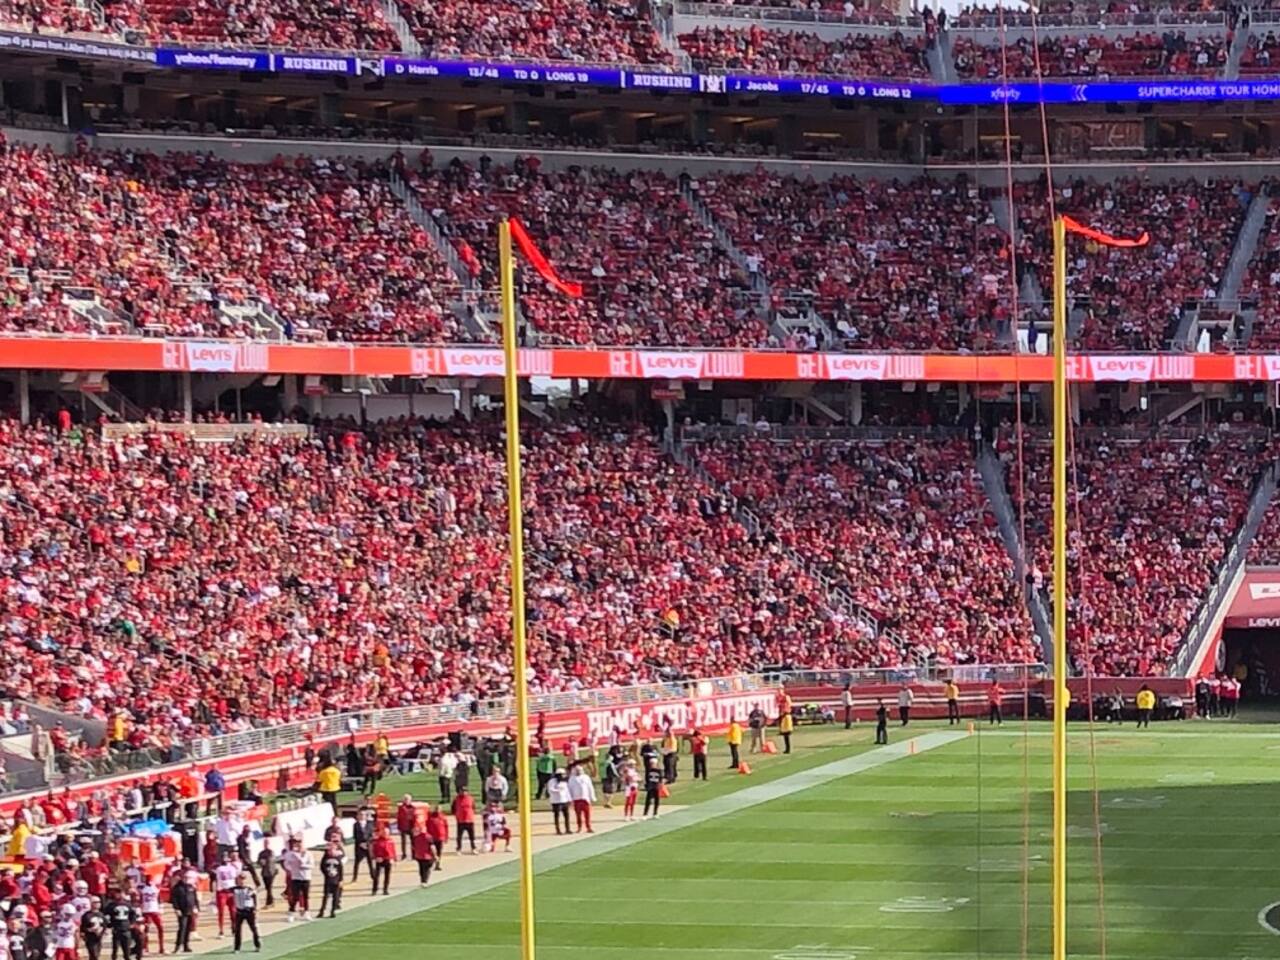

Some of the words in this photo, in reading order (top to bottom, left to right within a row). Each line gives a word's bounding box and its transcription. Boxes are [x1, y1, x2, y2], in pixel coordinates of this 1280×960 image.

[283, 53, 348, 72] RUSHING
[408, 65, 439, 75] Harris
[545, 71, 576, 82] LONG
[633, 74, 693, 88] RUSHING
[746, 80, 779, 91] Jacobs
[872, 87, 901, 98] LONG
[1138, 86, 1217, 97] SUPERCHARGE
[1219, 85, 1250, 96] YOUR
[163, 342, 186, 370] GET
[410, 348, 441, 375] GET
[610, 351, 638, 377] GET
[797, 354, 824, 380] GET
[1234, 355, 1264, 379] GET
